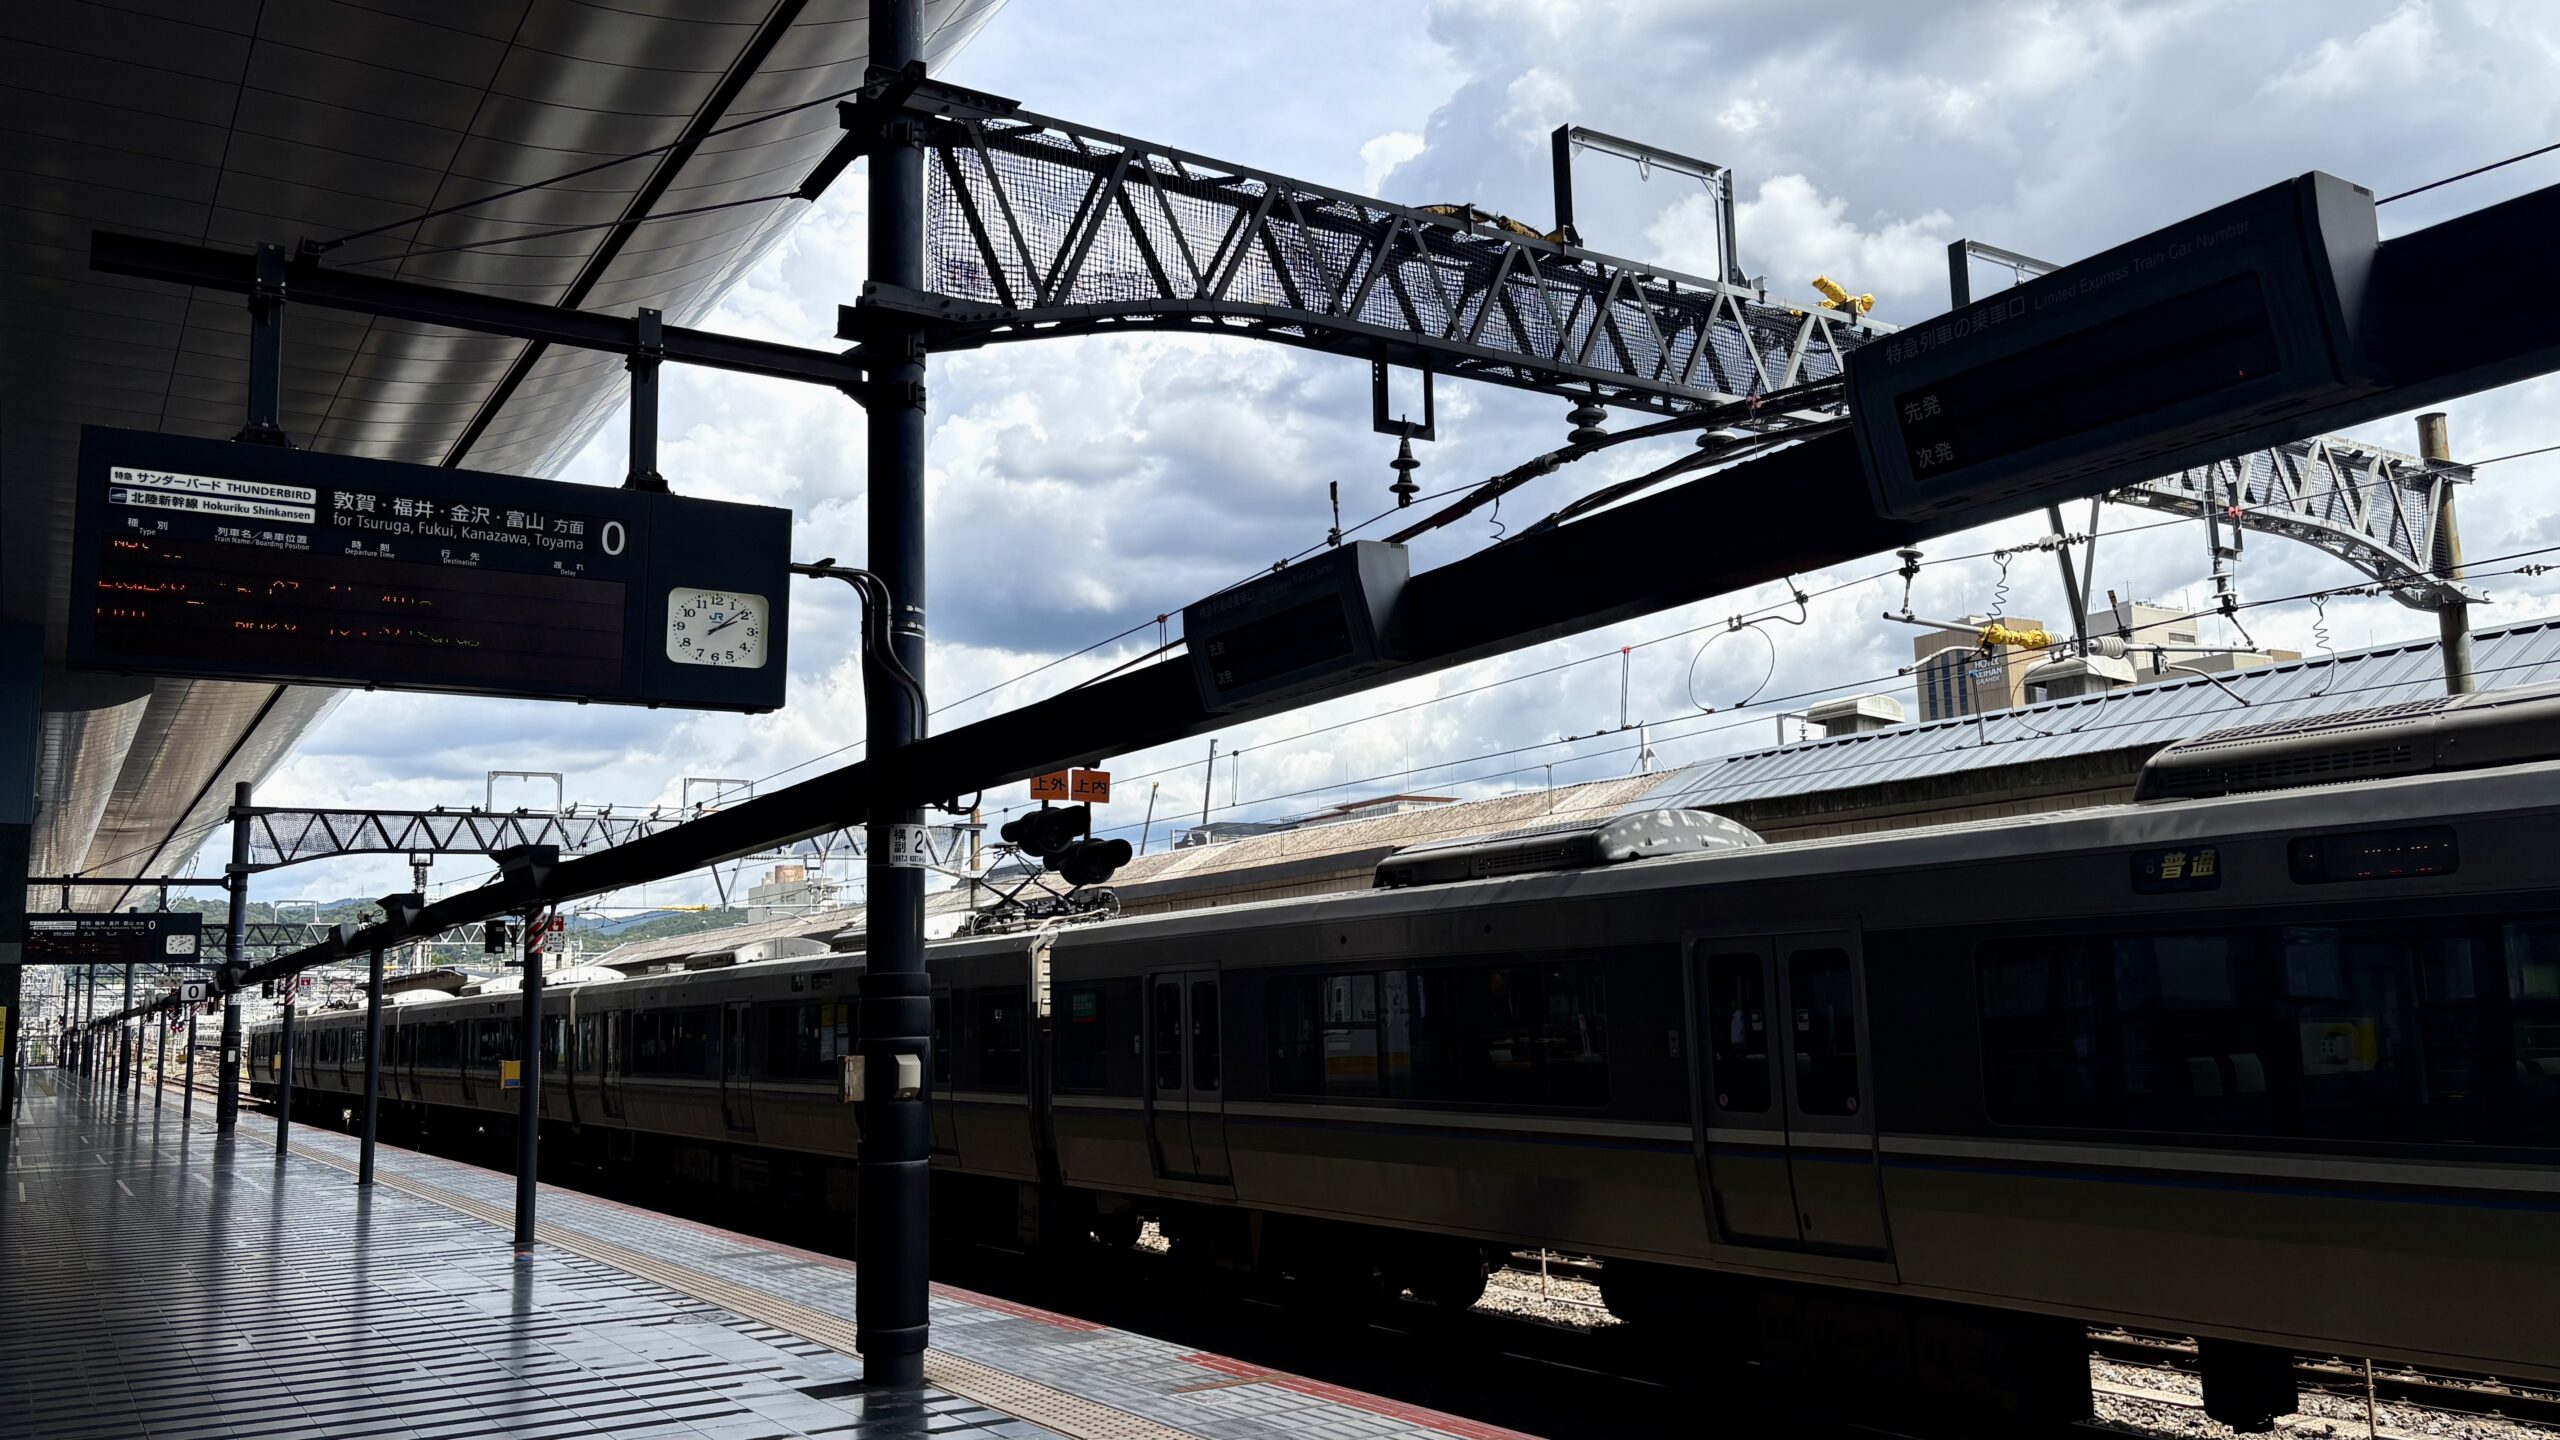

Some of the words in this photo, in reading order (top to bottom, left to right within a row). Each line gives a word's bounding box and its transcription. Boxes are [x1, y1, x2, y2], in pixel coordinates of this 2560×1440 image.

[1886, 296, 2025, 367] 特急列車の乗車口
[2035, 285, 2077, 311] Limited
[2080, 265, 2129, 294] Express
[2133, 251, 2166, 273] Train
[2168, 241, 2193, 261] Car
[2196, 219, 2249, 250] Number
[1904, 393, 1941, 425] 先発
[1915, 440, 1954, 469] 次発
[114, 471, 133, 481] 特急
[137, 472, 221, 490] サンダーバード
[227, 483, 312, 501] THUNDERBIRD
[131, 492, 198, 509] 北陸新幹線
[203, 500, 250, 514] Hokuriku
[253, 506, 311, 520] Shinkansen
[139, 528, 157, 536] Type
[333, 512, 353, 526] for
[357, 514, 414, 535] Tsuruga,
[419, 521, 457, 538] Fukui,
[462, 527, 532, 547] Kanazawa,
[535, 533, 584, 551] Toyama
[553, 518, 585, 535] 方面
[601, 521, 626, 556] 0
[214, 535, 230, 543] Train
[285, 542, 310, 551] Position
[345, 548, 378, 558] Departure
[379, 551, 395, 559] Time
[443, 557, 477, 567] Destination
[560, 568, 577, 577] Delay
[696, 599, 708, 609] 11
[711, 596, 724, 606] 12
[730, 601, 736, 611] 1
[683, 608, 696, 618] 10
[709, 612, 724, 621] JR
[740, 611, 750, 621] 2
[676, 621, 686, 631] 9
[746, 628, 755, 637] 3
[682, 637, 691, 647] 8
[739, 642, 748, 652] 4
[696, 648, 705, 658] 7
[711, 652, 720, 662] 6
[725, 650, 734, 660] 5
[1033, 777, 1066, 791] 上外
[1074, 780, 1107, 795] 上内
[914, 830, 924, 854] 2
[2161, 848, 2216, 880] 普通
[188, 985, 199, 998] 0
